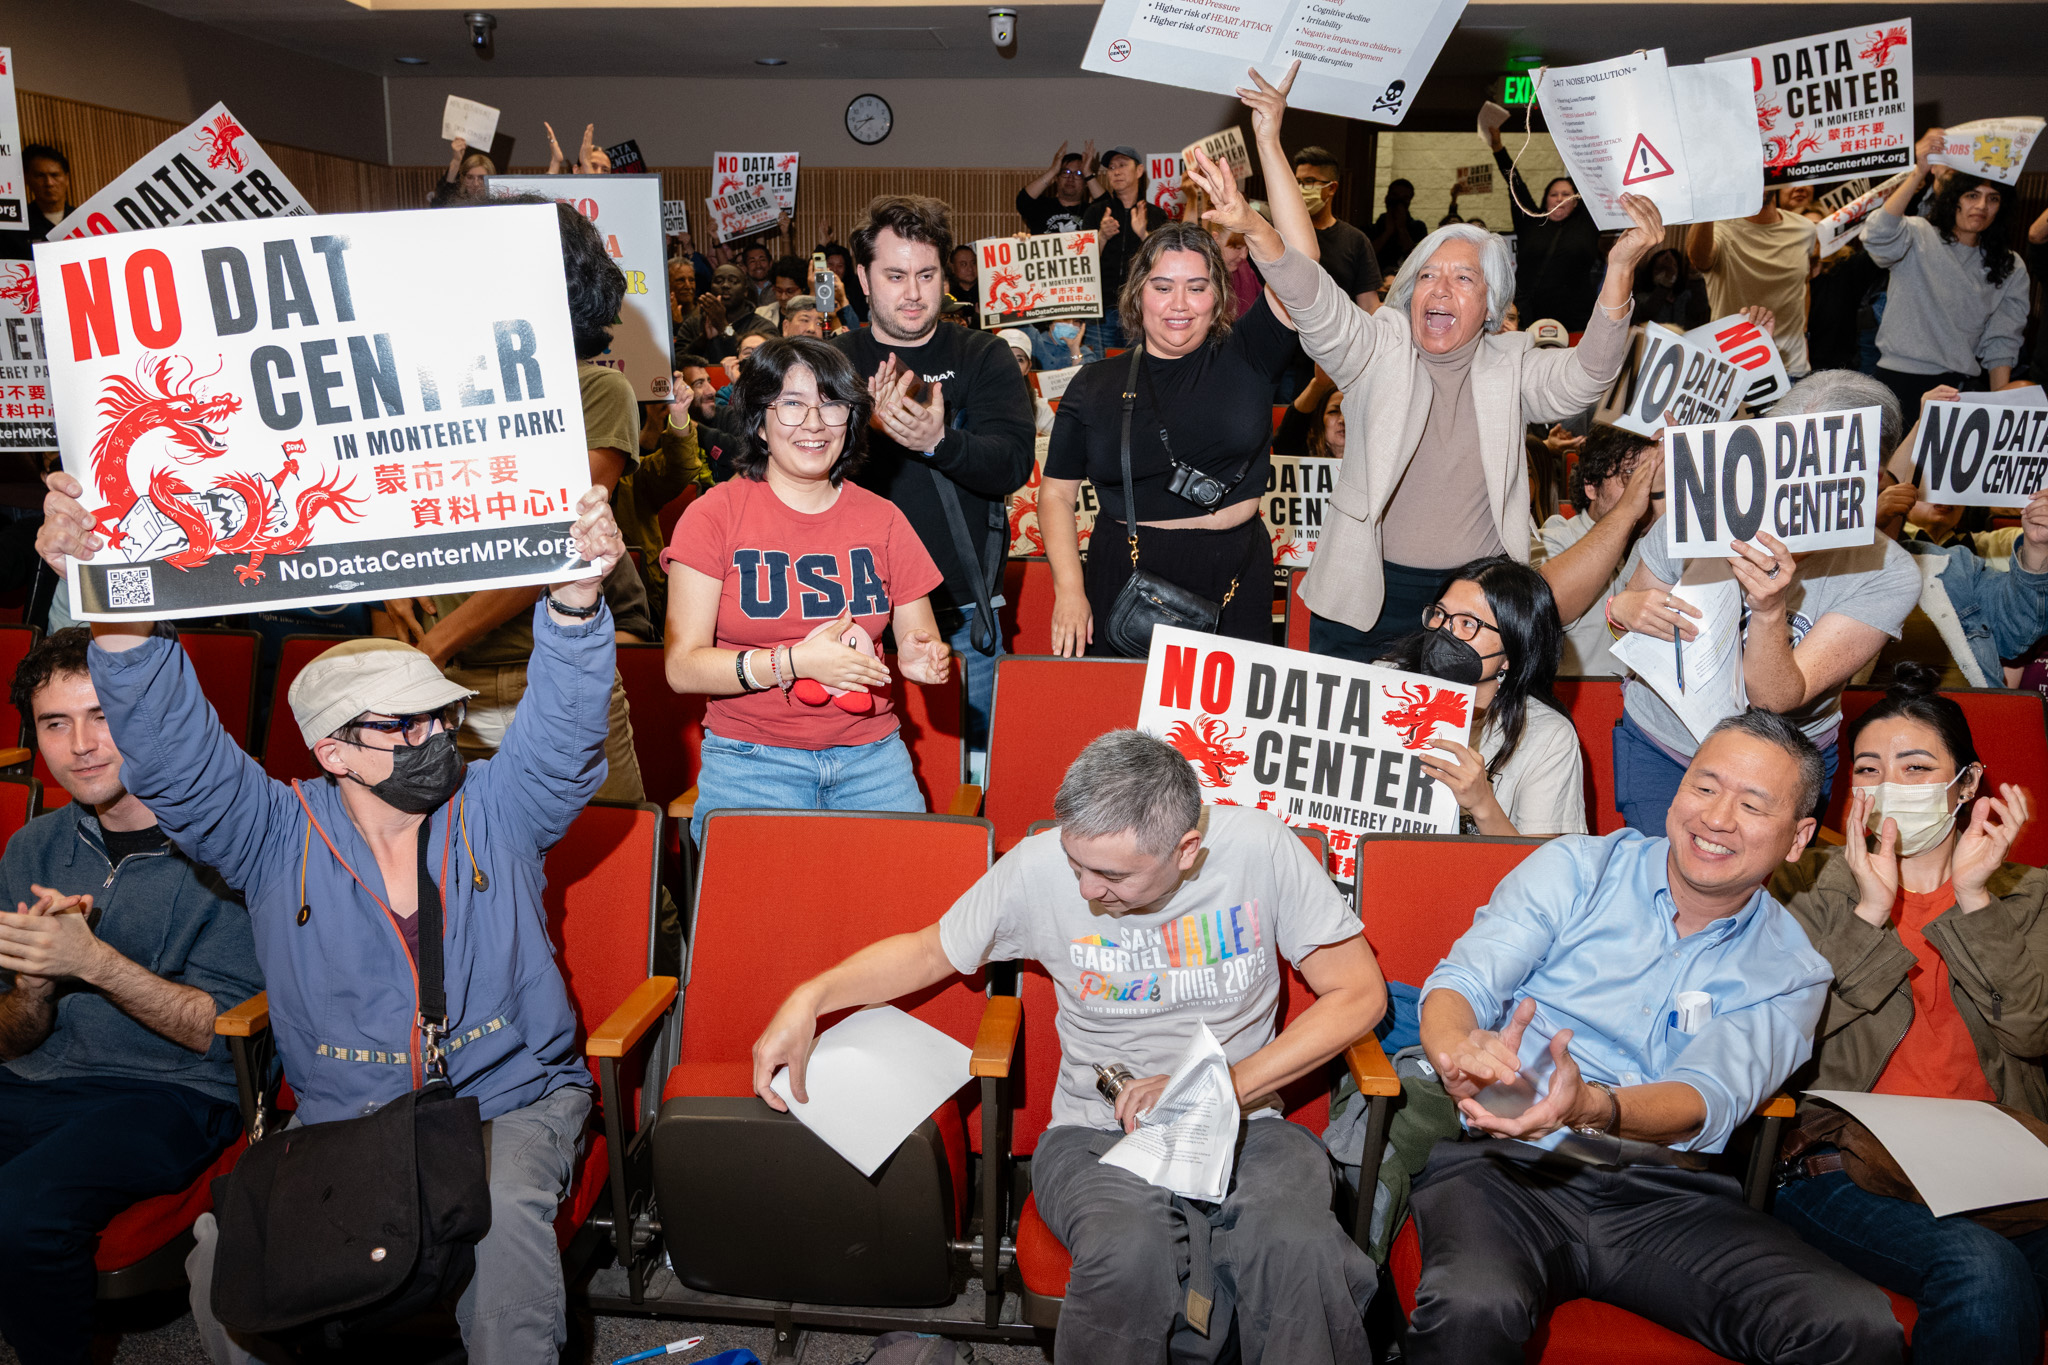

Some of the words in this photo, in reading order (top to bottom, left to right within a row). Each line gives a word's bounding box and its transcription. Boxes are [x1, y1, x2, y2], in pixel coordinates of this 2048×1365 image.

[1155, 2, 1184, 15] Higher
[1184, 9, 1200, 19] risk
[1200, 11, 1212, 20] of
[1211, 13, 1240, 26] HEART
[1239, 20, 1273, 33] ATTACK
[1205, 0, 1240, 13] Pressure
[1312, 4, 1345, 18] Cognitive
[1346, 12, 1371, 23] decline
[1149, 15, 1178, 28] Higher
[1178, 21, 1194, 31] risk
[1195, 24, 1206, 33] of
[1205, 26, 1240, 40] STROKE
[1306, 16, 1343, 31] Irritability
[1295, 39, 1325, 53] memory,
[1325, 44, 1340, 53] and
[1340, 49, 1384, 63] development
[1301, 27, 1332, 41] Negative
[1332, 35, 1360, 47] impacts
[1369, 41, 1402, 54] children's
[1291, 49, 1318, 61] Wildlife
[1317, 55, 1353, 69] disruption
[1772, 39, 1853, 86] DATA
[1553, 79, 1564, 88] 24/7
[1565, 75, 1586, 86] NOISE
[1586, 66, 1631, 83] POLLUTION
[1786, 67, 1899, 119] CENTER
[1814, 118, 1823, 128] IN
[1827, 110, 1875, 127] MONTEREY
[1878, 102, 1906, 117] PARK!
[1205, 132, 1236, 153] DATA
[1604, 137, 1622, 145] ATTACK
[1828, 121, 1885, 141] 蒙市不要
[1208, 145, 1246, 165] ENTER
[1840, 134, 1904, 154] 資料中心!
[1946, 144, 1970, 155] JOBS
[718, 156, 738, 173] NO
[742, 156, 775, 172] DATA
[1151, 157, 1174, 179] NO
[1457, 167, 1469, 178] NO
[1470, 164, 1489, 176] DATA
[1786, 152, 1906, 177] NoDataCenterMPK.org
[113, 152, 217, 231] DATA
[746, 172, 792, 187] CENTER
[1467, 173, 1492, 185] CENTER
[663, 201, 684, 217] DATA
[712, 196, 728, 212] NO
[728, 190, 752, 206] DATA
[735, 197, 768, 215] CENTER
[664, 216, 685, 232] CENTER
[983, 243, 1012, 269] NO
[1016, 237, 1064, 262] DATA
[1024, 256, 1091, 282] CENTER
[1049, 278, 1078, 287] MONTEREY
[1079, 276, 1096, 284] PARK!
[60, 248, 182, 362] NO
[1026, 305, 1098, 317] NoDataCenterMPK.org
[1714, 321, 1772, 371] NO
[923, 370, 956, 383] IMAX
[1606, 331, 1685, 424] NO
[1681, 351, 1738, 408] DATA
[333, 434, 359, 460] IN
[366, 418, 488, 456] MONTEREY
[497, 408, 566, 440] PARK!
[1911, 405, 1991, 494] NO
[373, 454, 519, 495] 蒙市不要
[1265, 464, 1333, 493] DATA
[1672, 424, 1767, 543] NO
[1775, 412, 1867, 480] DATA
[1981, 454, 2048, 495] CENTER
[411, 487, 569, 529] 資料中心!
[1270, 497, 1327, 527] CEN
[1773, 476, 1866, 538] CENTER
[1294, 529, 1303, 539] IN
[279, 536, 577, 582] NoDataCenterMPK.org
[733, 547, 890, 620] USA
[1159, 644, 1235, 715] NO
[1245, 662, 1371, 738] DATA
[1252, 729, 1437, 815] CENTER
[1288, 797, 1301, 815] IN
[1308, 801, 1388, 832] MONTEREY
[1120, 926, 1162, 951] SAN
[1161, 897, 1262, 968] VALLEY
[1069, 944, 1168, 973] GABRIEL
[1079, 970, 1162, 1002] Pride
[1168, 967, 1219, 1004] TOUR
[1222, 946, 1266, 995] 2023
[1151, 1006, 1173, 1014] PRIDE
[1219, 994, 1248, 1005] GABRIEL
